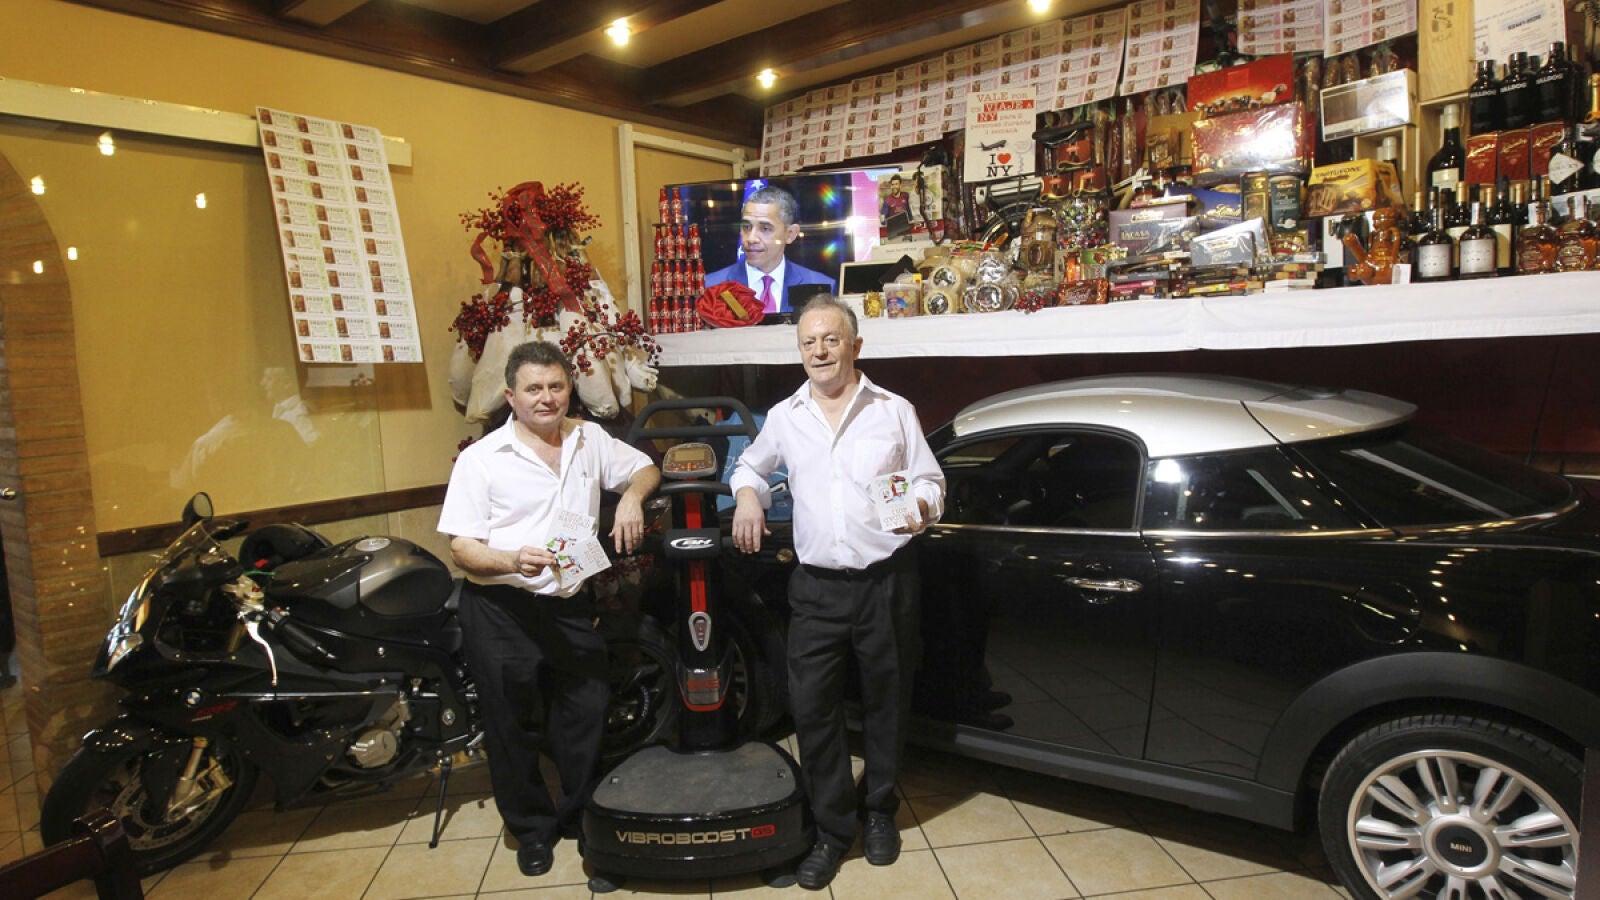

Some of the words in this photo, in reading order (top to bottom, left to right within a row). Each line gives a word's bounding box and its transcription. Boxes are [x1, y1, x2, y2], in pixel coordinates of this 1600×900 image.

[977, 92, 1008, 103] VALE
[979, 112, 997, 122] NY
[989, 153, 997, 165] I
[986, 165, 1014, 178] NY
[615, 827, 751, 845] VIBROBOOST
[1450, 842, 1473, 853] MINI
